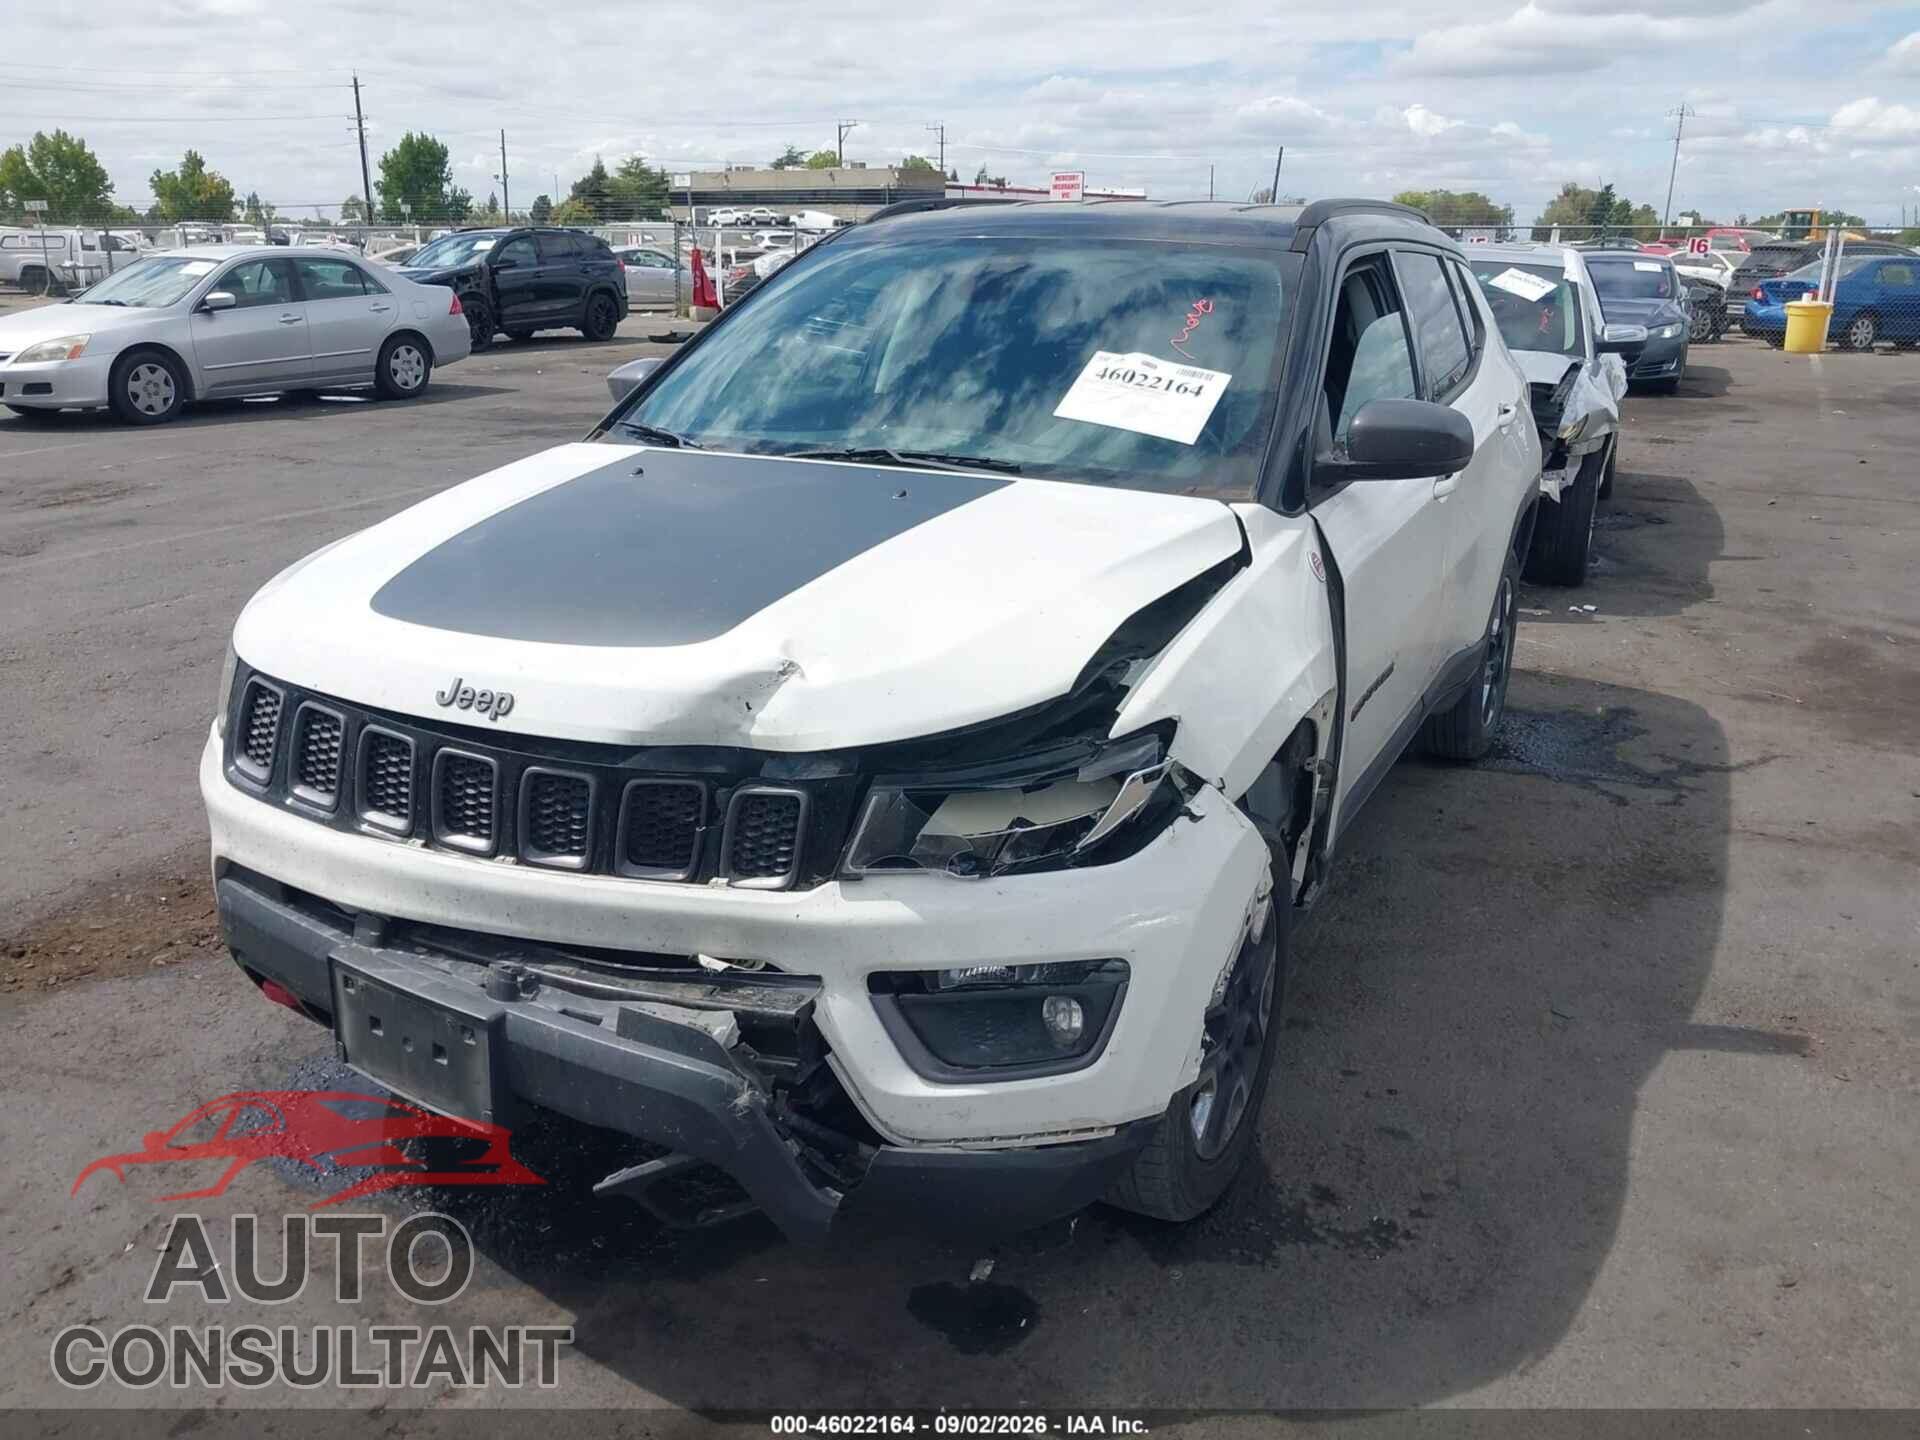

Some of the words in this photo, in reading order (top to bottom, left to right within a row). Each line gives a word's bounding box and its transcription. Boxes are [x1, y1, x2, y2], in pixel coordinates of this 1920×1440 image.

[1690, 238, 1709, 254] 16
[1096, 367, 1204, 397] 46022164
[436, 677, 515, 721] Jeep
